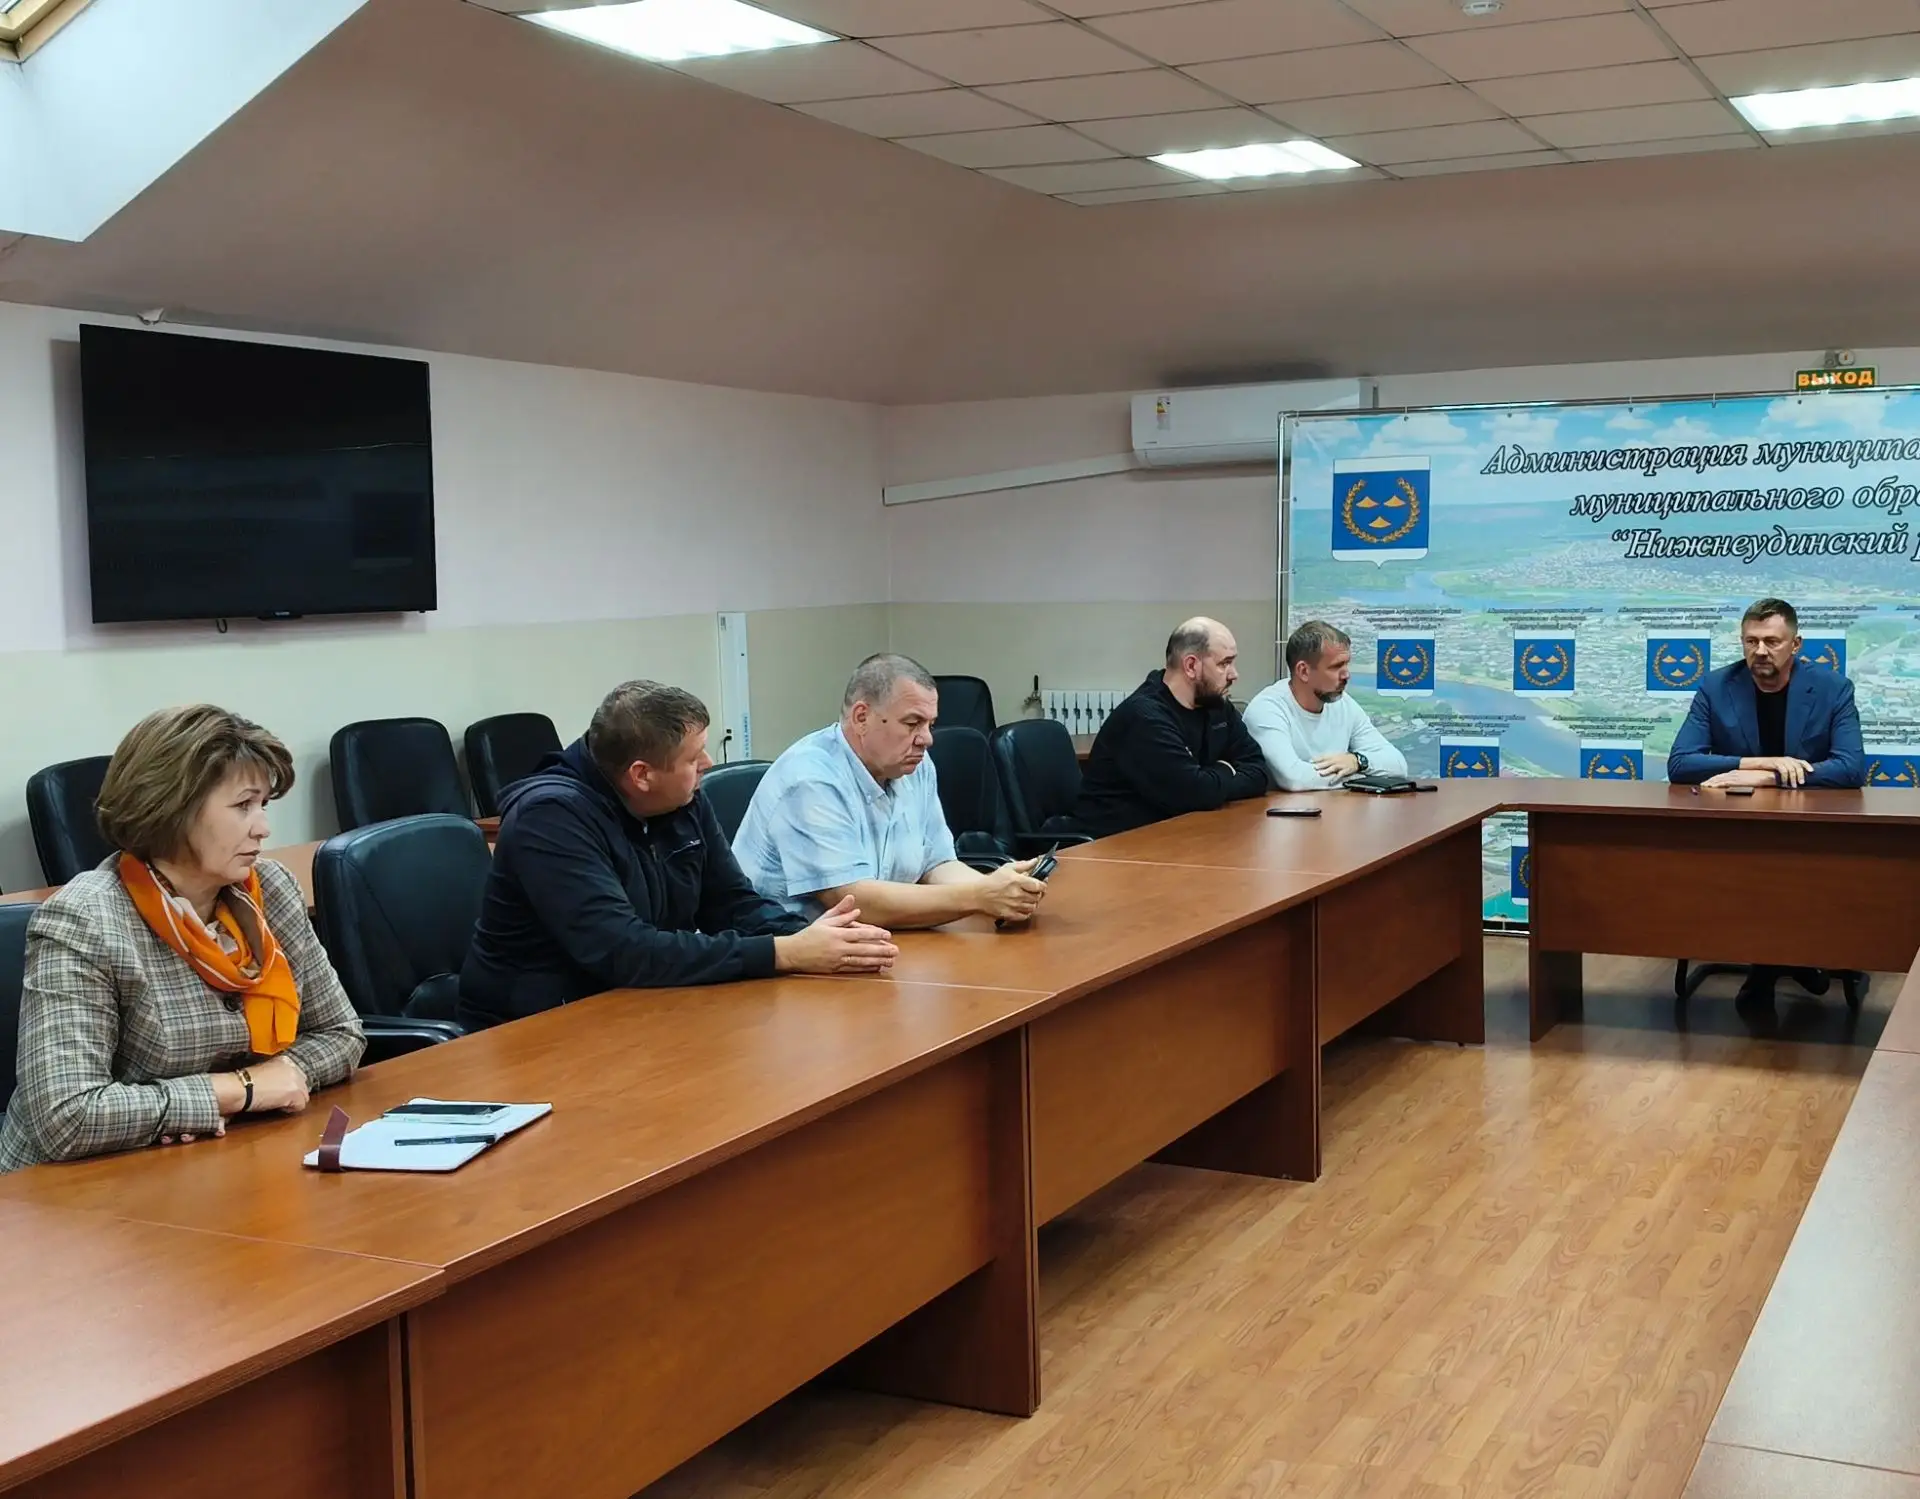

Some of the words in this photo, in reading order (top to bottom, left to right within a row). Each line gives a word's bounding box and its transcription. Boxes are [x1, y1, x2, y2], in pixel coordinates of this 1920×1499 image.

[1798, 370, 1873, 387] ВЫХОД
[1480, 439, 1747, 477] Администрация
[1570, 486, 1844, 522] муниципального
[1853, 475, 1920, 515] обр
[1611, 522, 1909, 563] “Нижнеудинский
